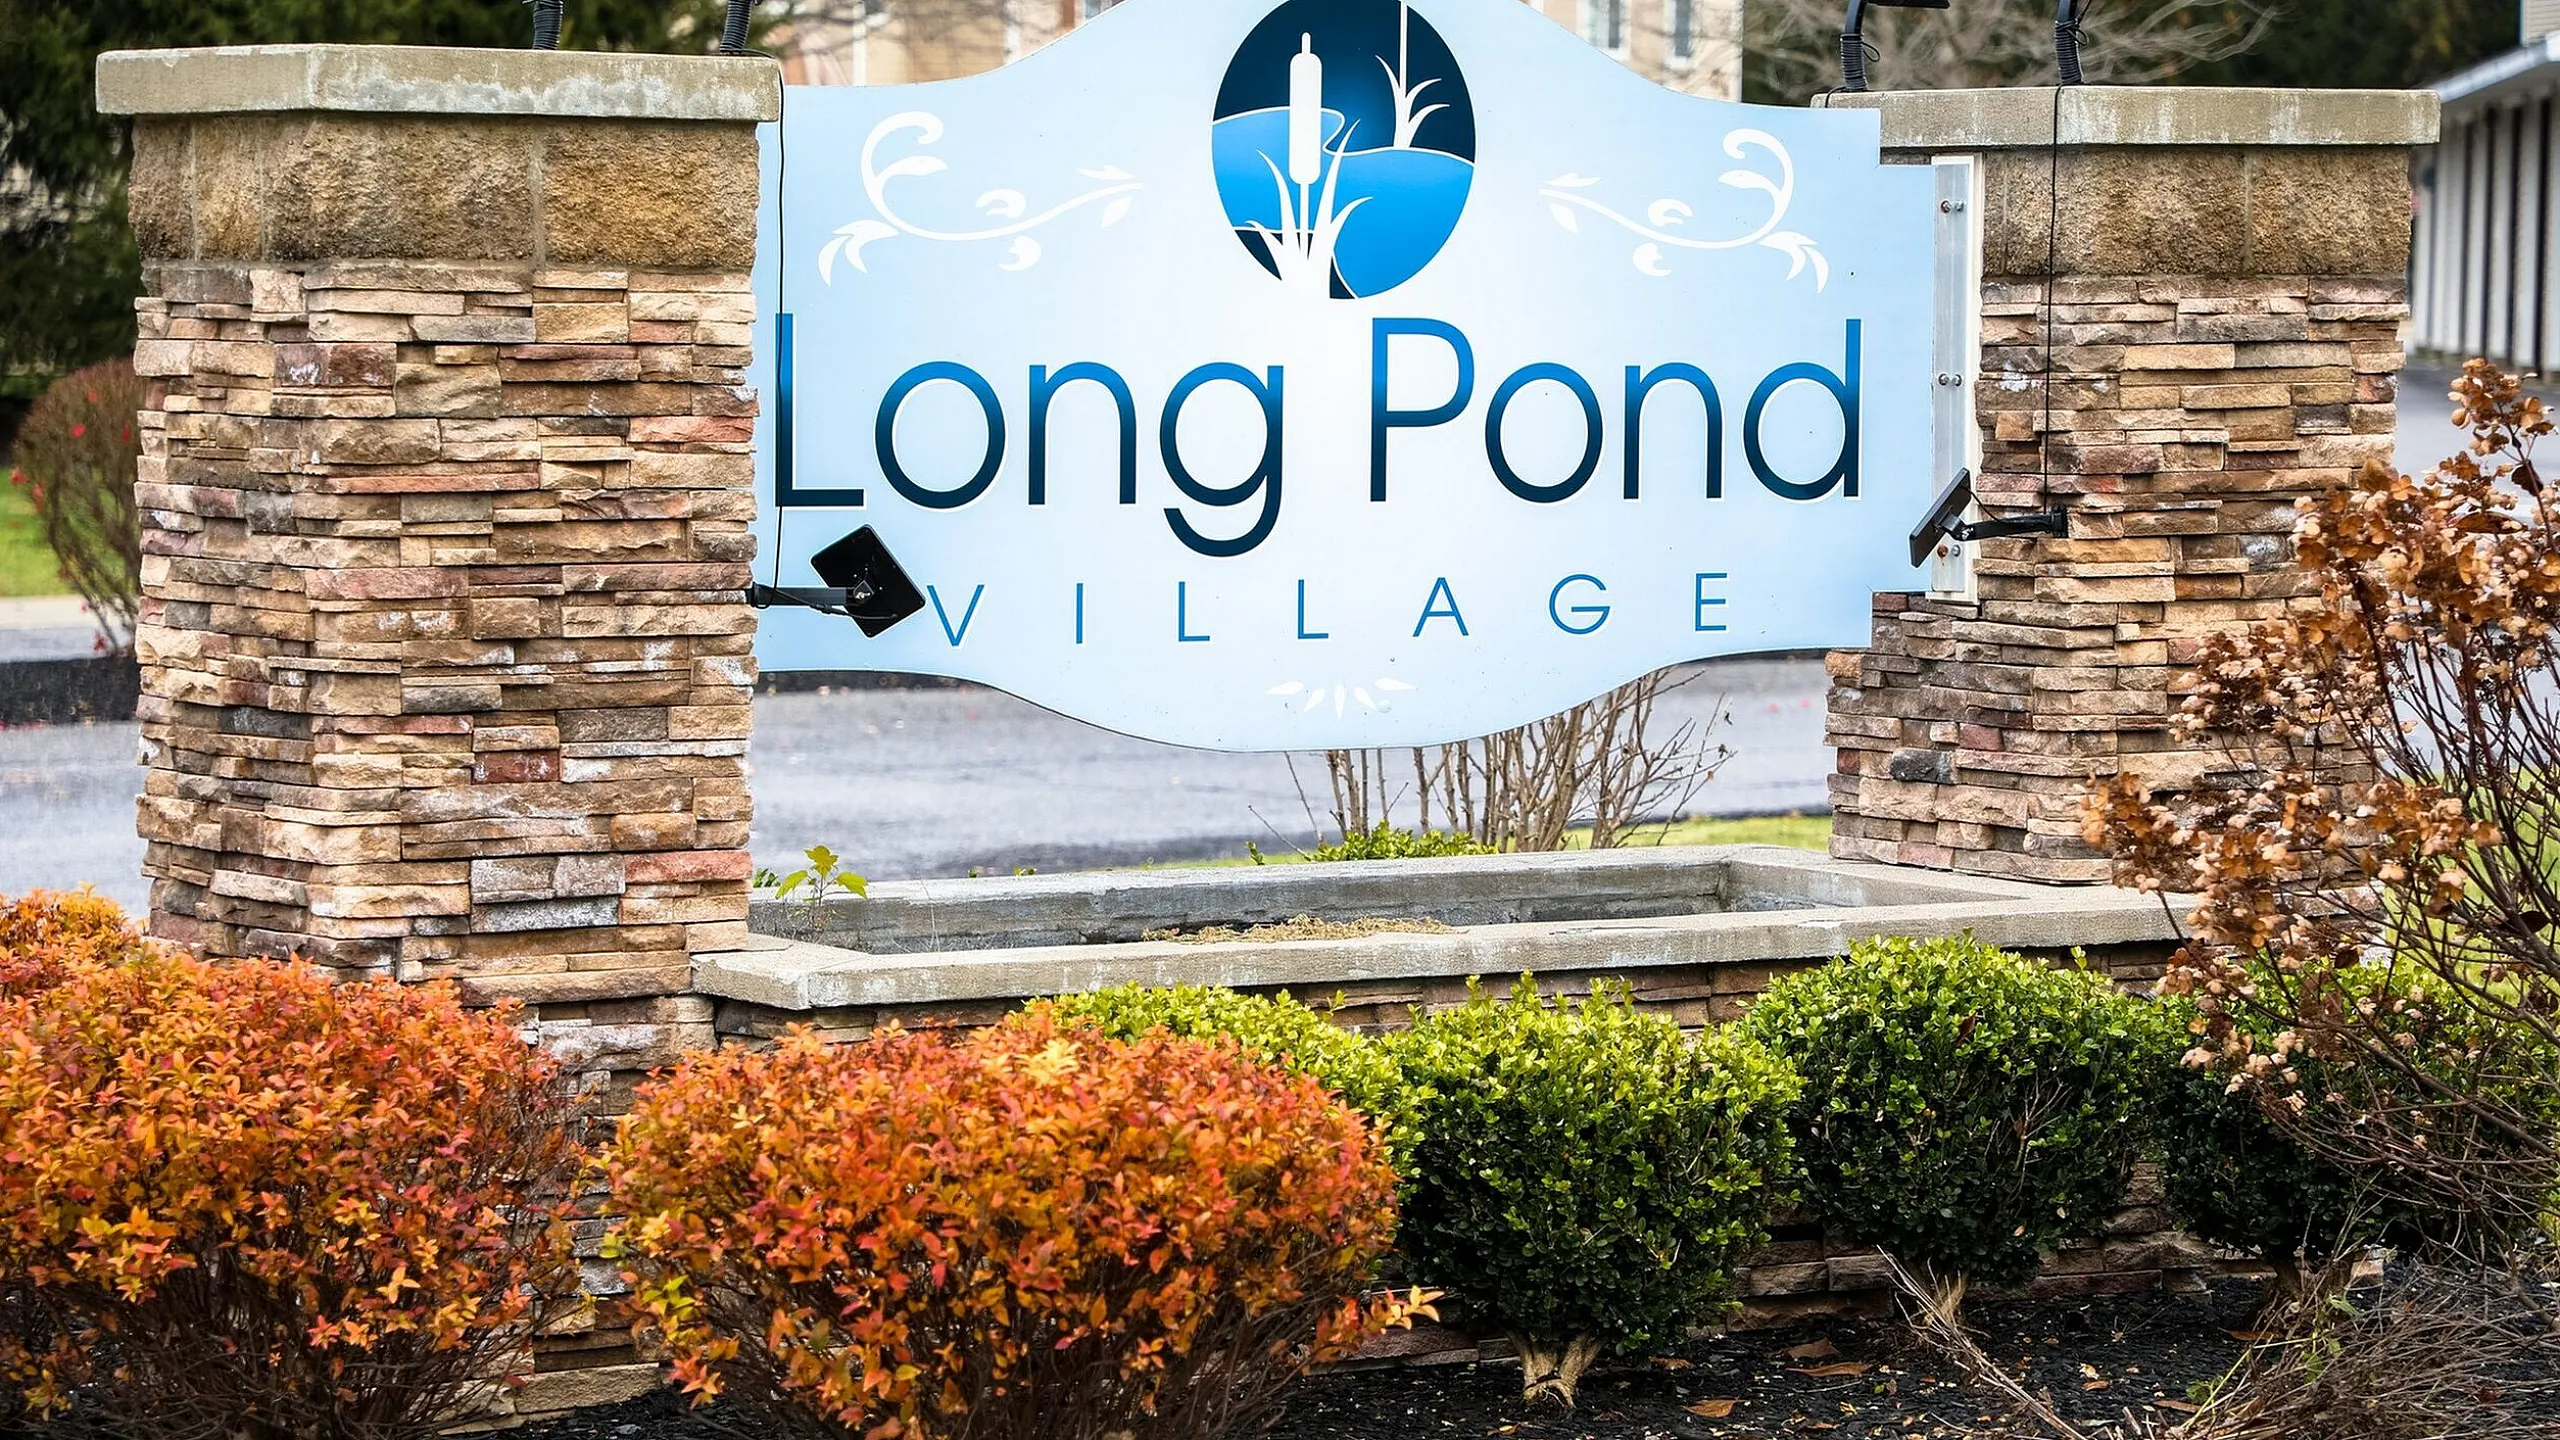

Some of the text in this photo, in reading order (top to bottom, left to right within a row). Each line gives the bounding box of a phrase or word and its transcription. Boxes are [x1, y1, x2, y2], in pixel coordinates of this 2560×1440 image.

[775, 313, 1862, 557] Long Pond
[926, 572, 1728, 647] VILLAGE
